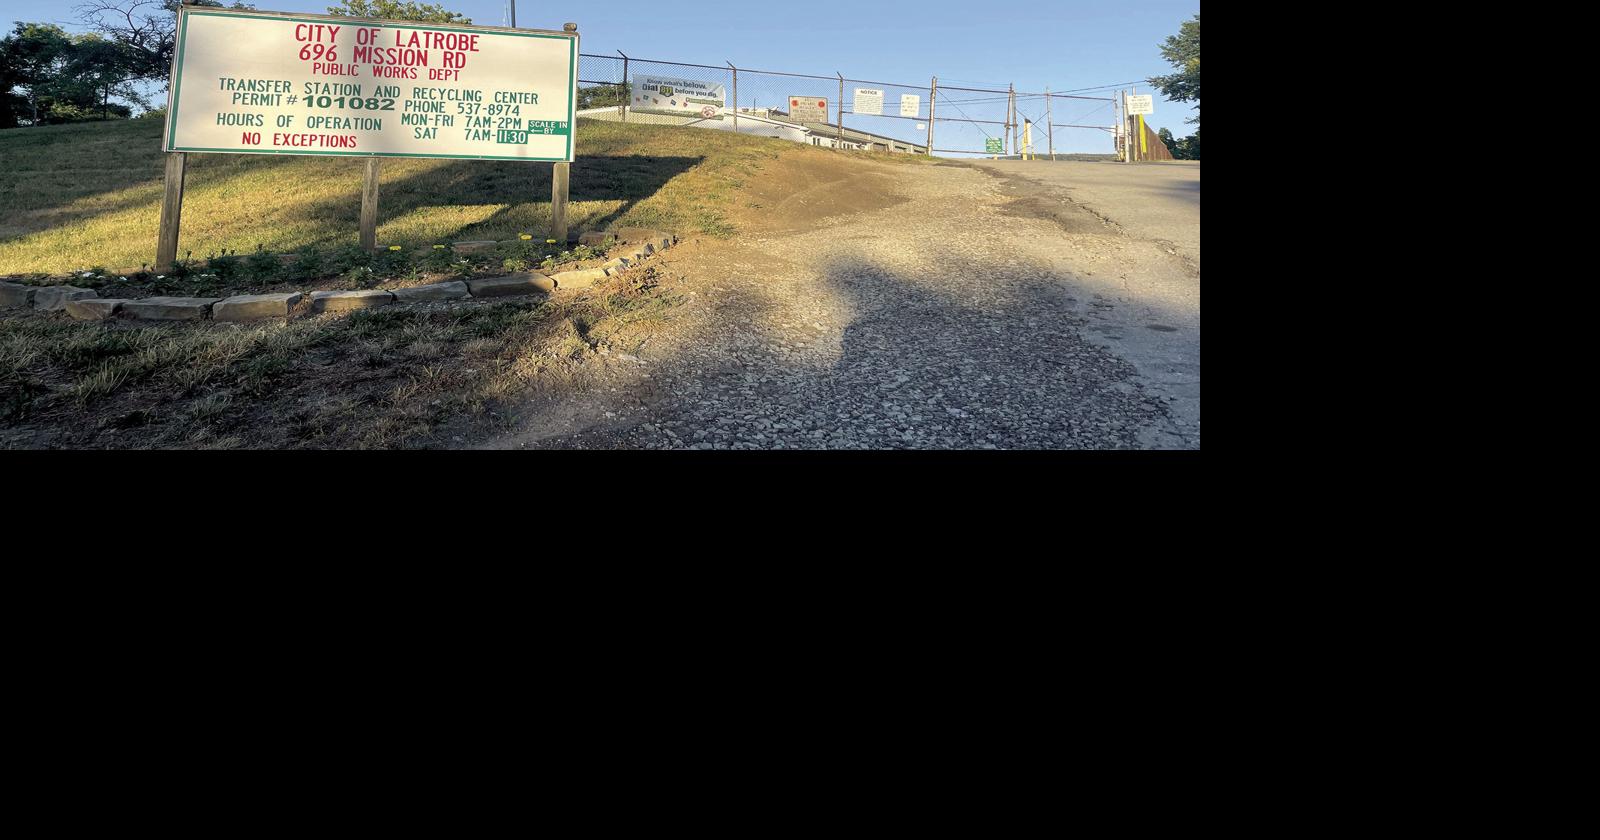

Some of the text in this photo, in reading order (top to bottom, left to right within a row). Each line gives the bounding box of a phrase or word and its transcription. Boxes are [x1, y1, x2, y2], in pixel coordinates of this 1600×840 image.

[295, 24, 479, 51] CITY OF LATROBE
[299, 44, 466, 68] 696 MISSION RD
[313, 63, 460, 81] PUBLIC WORKS DEPT
[219, 78, 539, 105] TRANSFER STATION AND RECYCLING CENTER
[684, 81, 707, 89] below.
[232, 92, 282, 106] PERMIT
[302, 96, 395, 110] 101082
[405, 100, 446, 113] PHONE
[457, 103, 520, 116] 537-8974
[216, 113, 522, 130] HOURS OF OPERATION MON-FRI 7AM-2PM
[530, 120, 556, 128] SCALE
[242, 132, 357, 148] NO EXCEPTIONS
[414, 127, 438, 139] SAT
